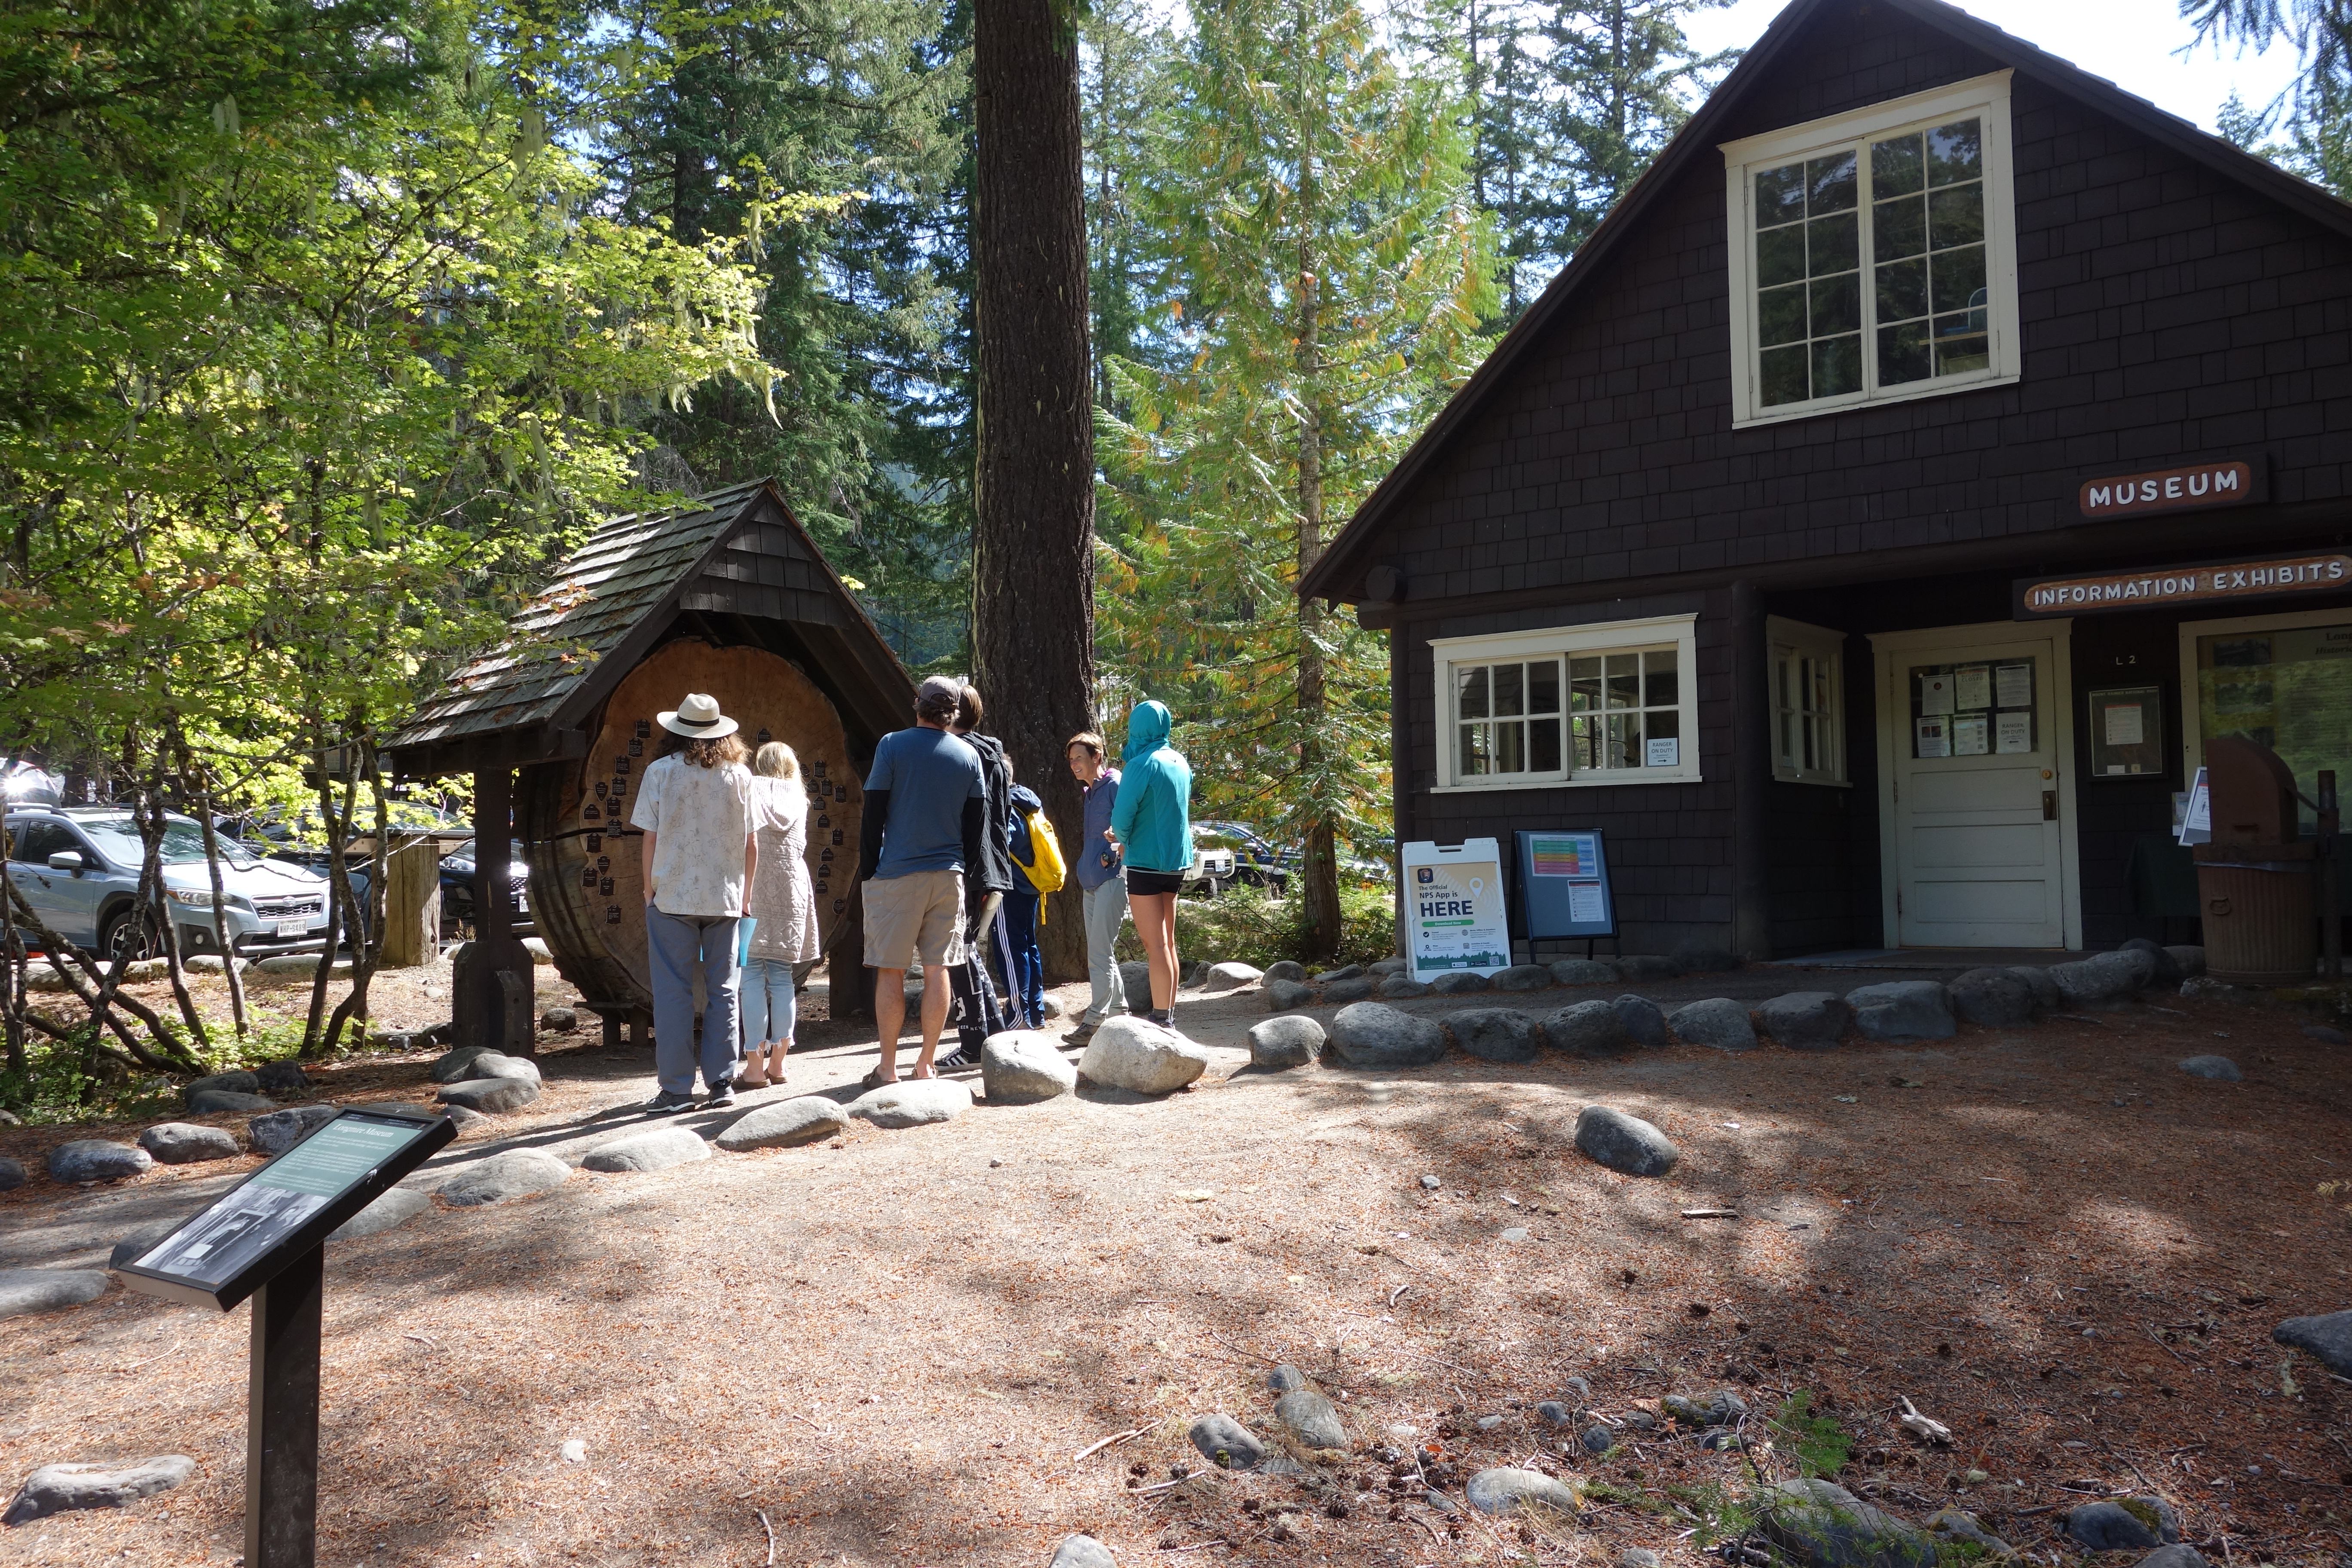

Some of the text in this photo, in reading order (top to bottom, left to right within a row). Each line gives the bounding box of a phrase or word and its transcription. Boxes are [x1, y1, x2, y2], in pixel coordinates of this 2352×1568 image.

[2089, 470, 2238, 508] MUSEUM
[2034, 561, 2344, 606] INFORMATION EXHIBITS
[2116, 655, 2136, 665] L 2
[1421, 900, 1473, 917] HERE
[333, 1124, 394, 1137] Longmire Museum
